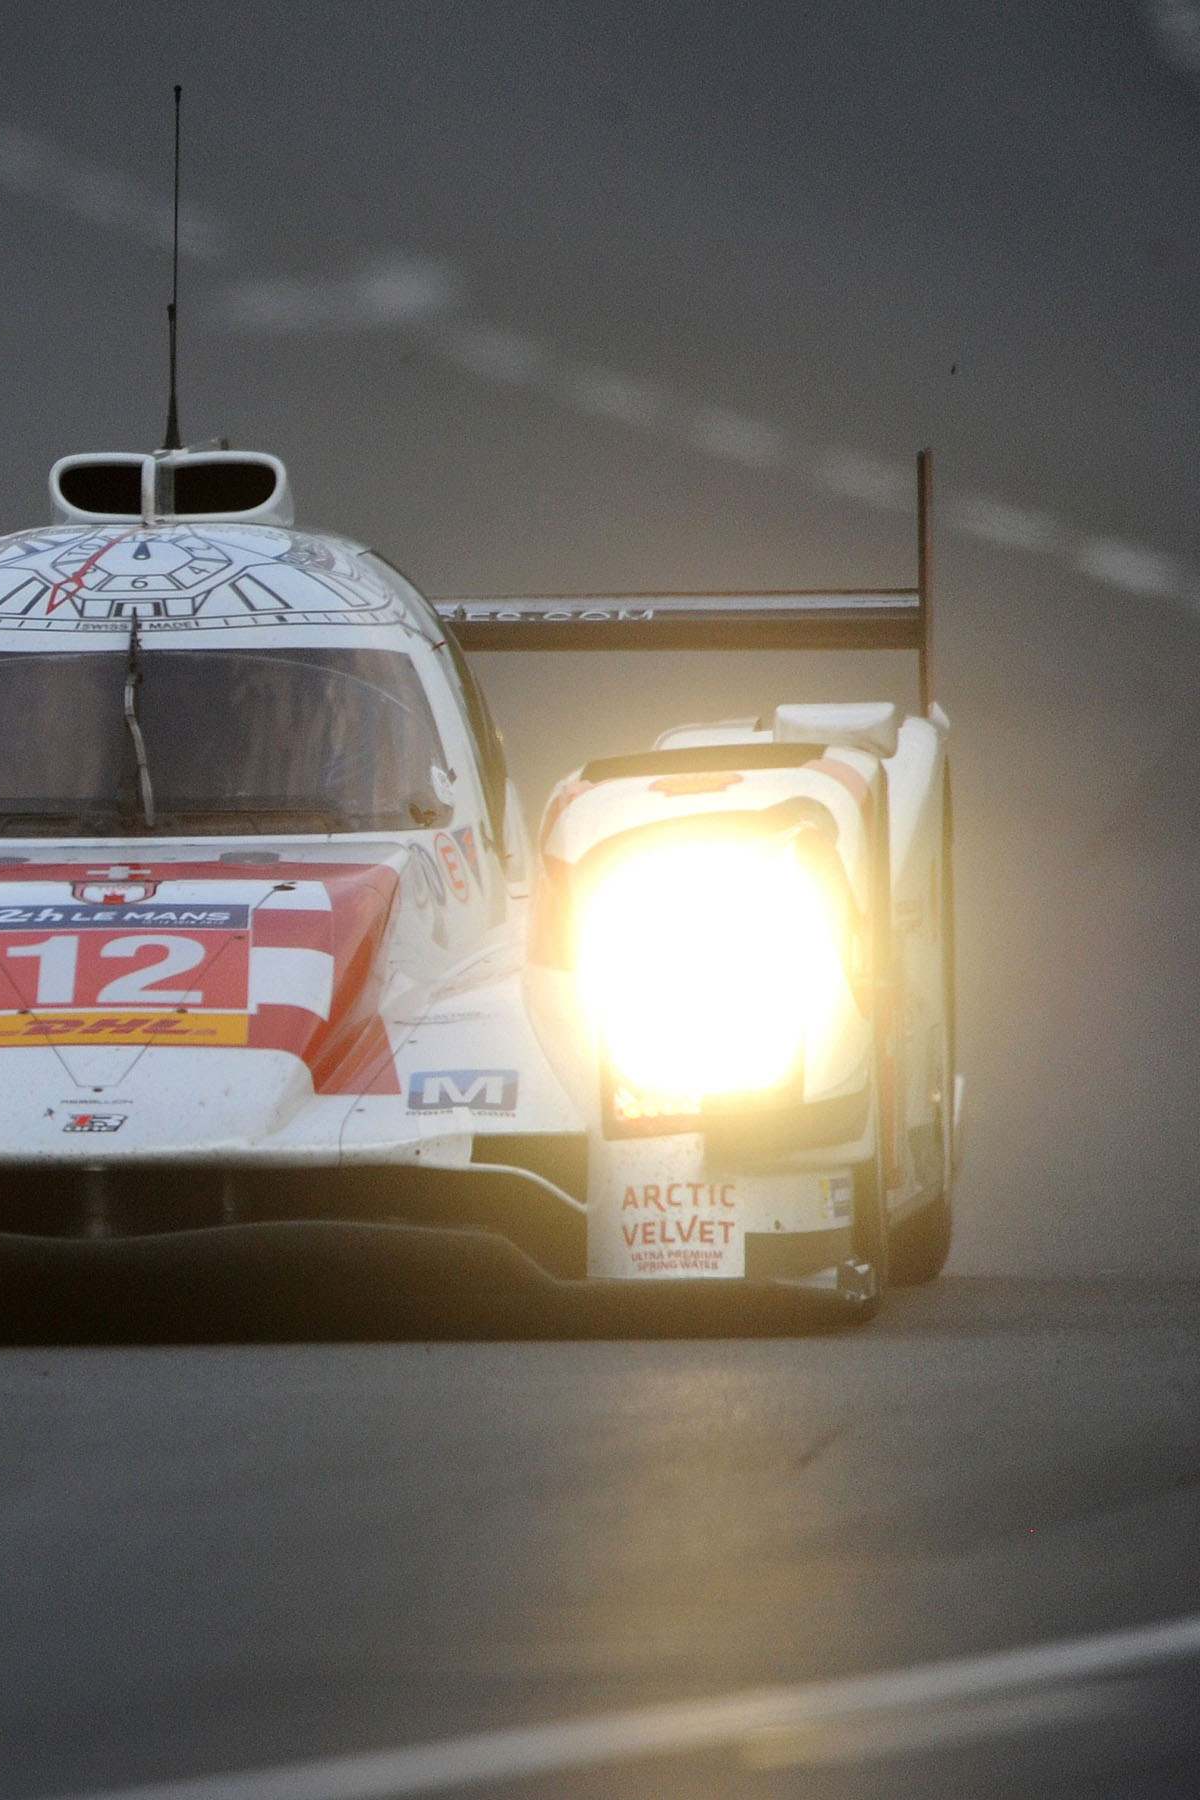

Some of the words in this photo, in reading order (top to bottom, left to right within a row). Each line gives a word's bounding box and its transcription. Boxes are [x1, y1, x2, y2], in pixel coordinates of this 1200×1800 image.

[186, 565, 211, 576] 4
[130, 576, 149, 589] 6
[81, 622, 129, 631] SWISS
[148, 621, 193, 630] MADE
[70, 911, 117, 923] LE
[122, 910, 231, 922] MANS
[6, 934, 207, 1004] 12
[21, 1017, 190, 1036] DHL
[621, 1182, 736, 1212] ARCTIC
[621, 1215, 736, 1247] VELVET
[631, 1250, 665, 1262] ULTRA
[667, 1250, 724, 1261] PREMIUM
[636, 1260, 678, 1272] SPRING
[680, 1260, 719, 1271] WATER
